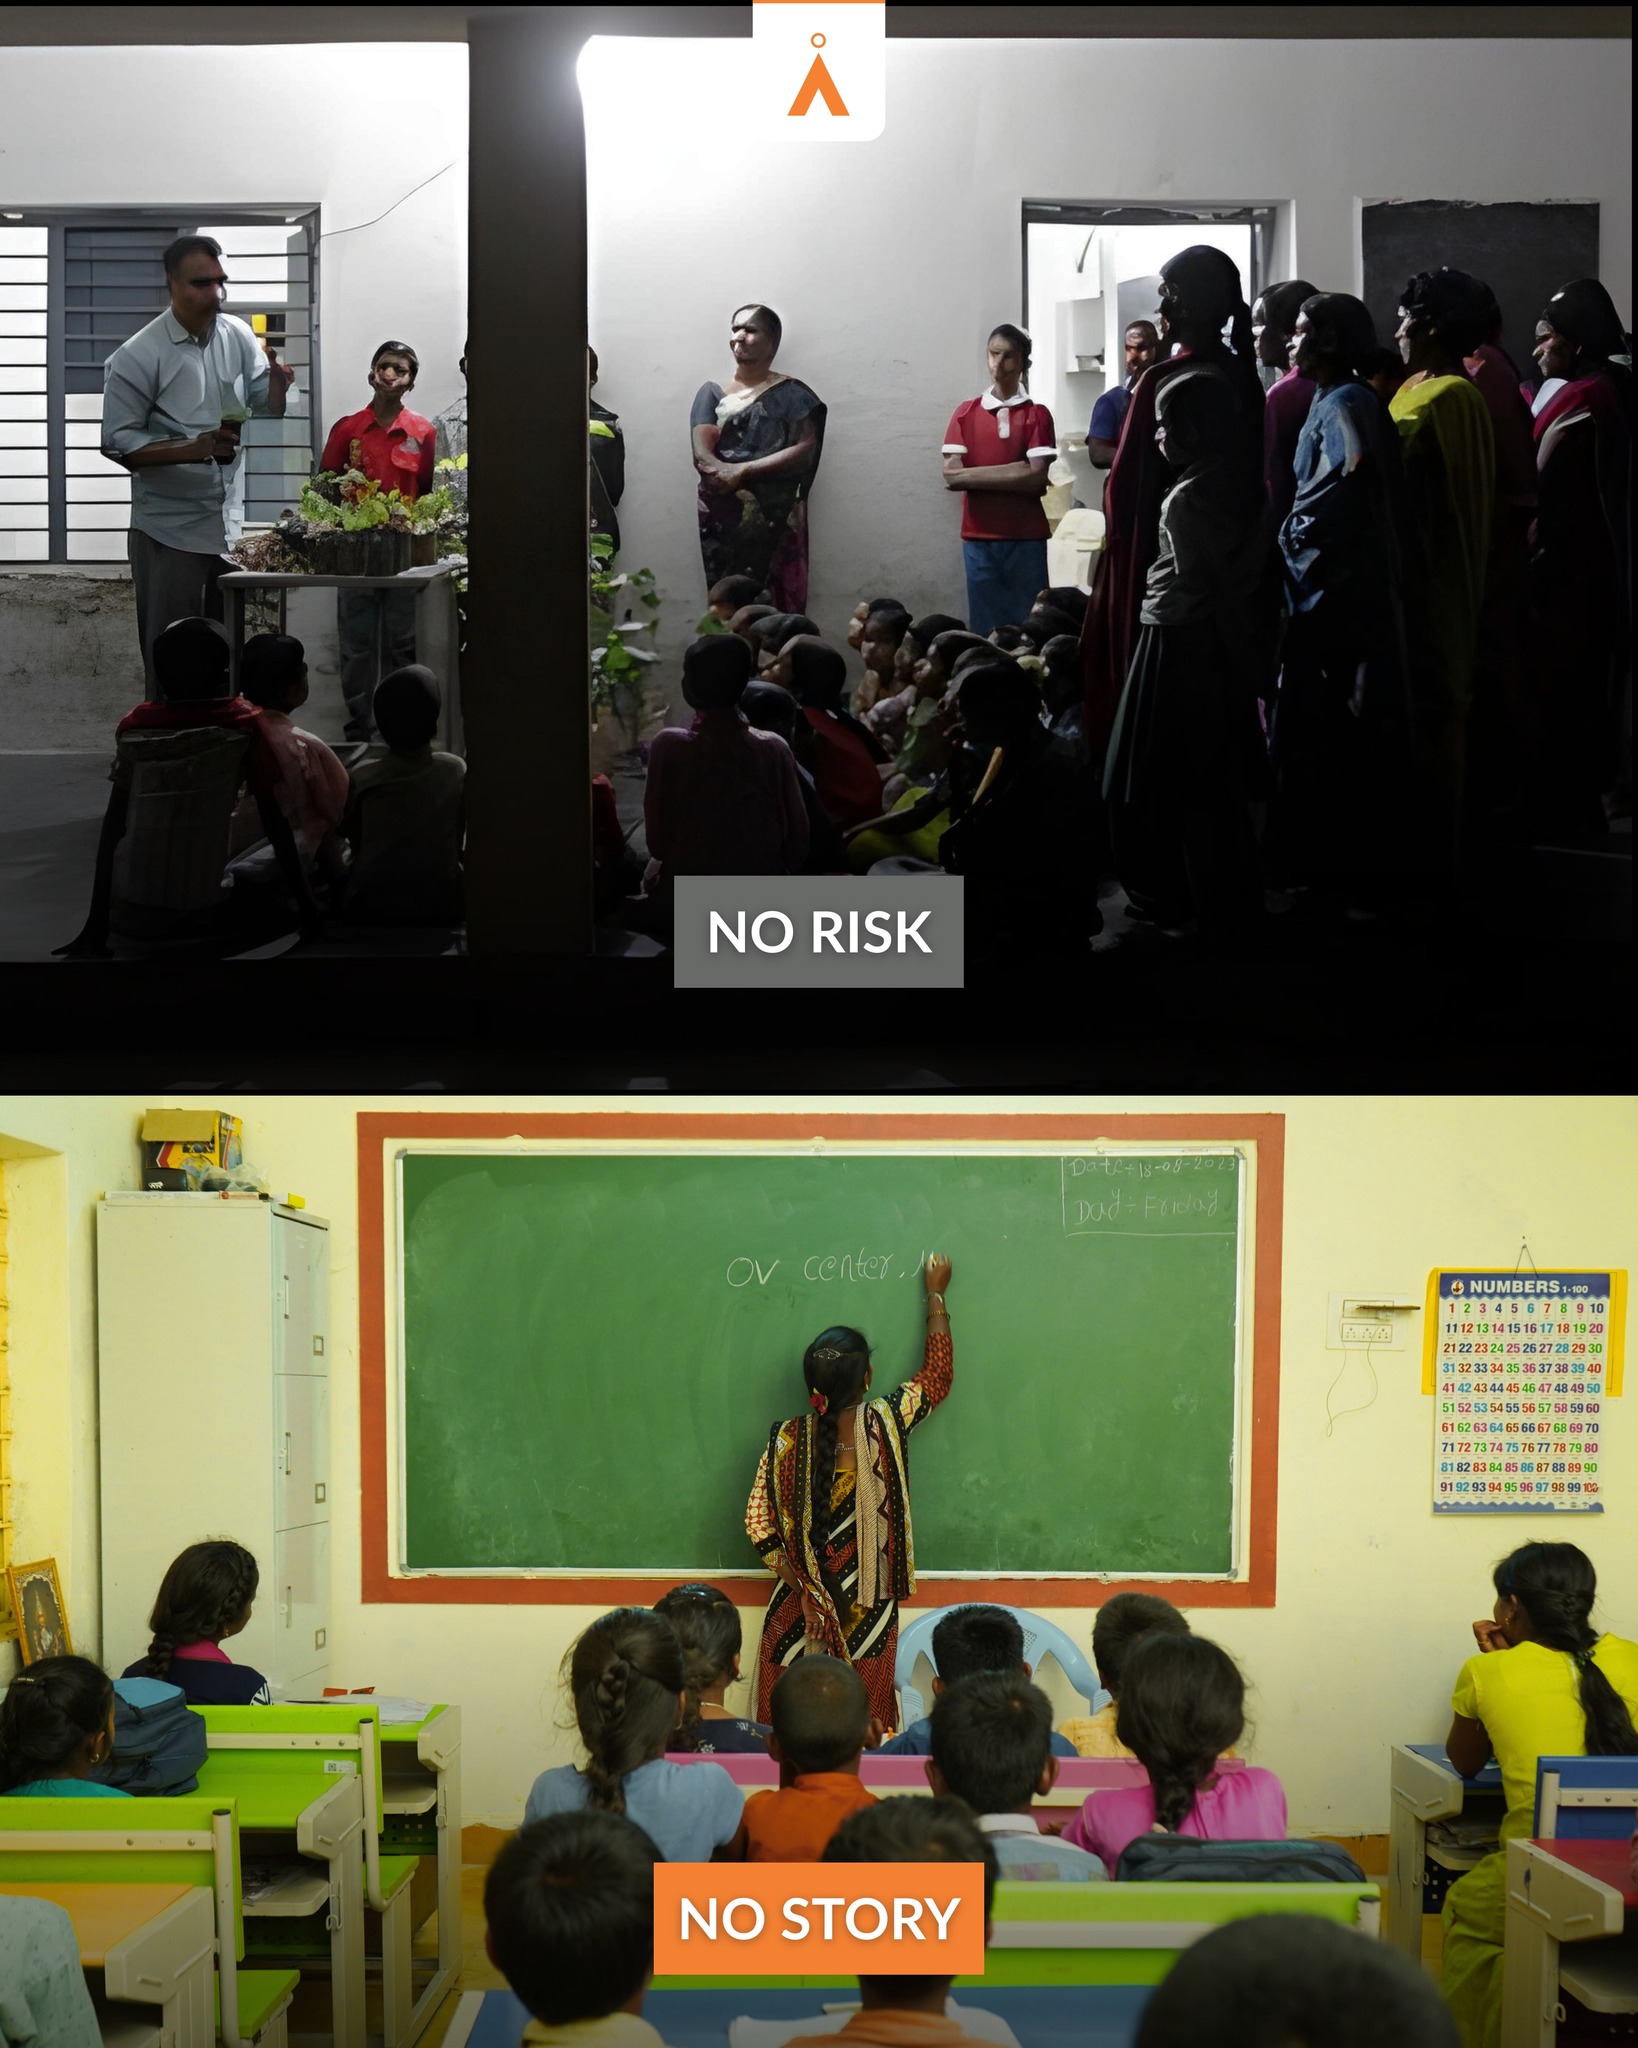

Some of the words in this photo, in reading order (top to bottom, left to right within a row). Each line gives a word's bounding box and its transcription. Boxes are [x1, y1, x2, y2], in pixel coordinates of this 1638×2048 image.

[1470, 1280, 1560, 1294] NUMBERS
[1562, 1285, 1589, 1294] 1-100
[1450, 1302, 1454, 1314] 1
[1464, 1302, 1470, 1314] 2
[1480, 1302, 1486, 1314] 3
[1494, 1302, 1502, 1314] 4
[1510, 1302, 1518, 1314] 5
[1526, 1302, 1534, 1314] 6
[1544, 1304, 1550, 1314] 7
[1560, 1302, 1568, 1314] 8
[1576, 1302, 1584, 1314] 9
[1592, 1302, 1604, 1314] 10
[1446, 1322, 1458, 1334] 11
[1462, 1322, 1474, 1334] 12
[1478, 1322, 1490, 1334] 13
[1492, 1324, 1504, 1334] 14
[1508, 1324, 1520, 1334] 15
[1524, 1322, 1538, 1334] 16
[1540, 1322, 1554, 1334] 17
[1558, 1322, 1570, 1334] 18
[1574, 1324, 1586, 1334] 19
[1588, 1324, 1604, 1334] 20
[1444, 1342, 1456, 1354] 21
[1458, 1342, 1472, 1354] 22
[1474, 1342, 1488, 1354] 23
[1490, 1342, 1504, 1354] 24
[1506, 1342, 1520, 1354] 25
[1522, 1342, 1536, 1354] 26
[1538, 1342, 1552, 1354] 27
[1556, 1342, 1570, 1354] 28
[1572, 1344, 1586, 1354] 29
[1588, 1344, 1602, 1354] 30
[1442, 1362, 1456, 1374] 31
[1458, 1362, 1472, 1374] 32
[1474, 1362, 1488, 1374] 33
[1490, 1362, 1504, 1374] 34
[1506, 1362, 1520, 1374] 35
[1522, 1362, 1536, 1374] 36
[1538, 1362, 1552, 1374] 37
[1554, 1362, 1568, 1374] 38
[1570, 1362, 1586, 1374] 39
[1586, 1364, 1602, 1374] 40
[1442, 1382, 1454, 1392] 41
[1458, 1382, 1472, 1392] 42
[1474, 1382, 1488, 1394] 43
[1490, 1382, 1504, 1392] 44
[1506, 1382, 1520, 1394] 45
[1522, 1382, 1536, 1394] 46
[1538, 1382, 1552, 1394] 47
[1554, 1382, 1568, 1394] 48
[1570, 1382, 1584, 1394] 49
[1586, 1382, 1600, 1394] 50
[1442, 1402, 1454, 1414] 51
[1458, 1402, 1472, 1412] 52
[1474, 1402, 1488, 1414] 53
[1490, 1402, 1504, 1412] 54
[1506, 1402, 1520, 1414] 55
[1522, 1402, 1536, 1414] 56
[1538, 1402, 1552, 1414] 57
[1554, 1402, 1568, 1414] 58
[1570, 1402, 1584, 1414] 59
[1586, 1402, 1600, 1414] 60
[1442, 1422, 1454, 1432] 61
[1458, 1422, 1472, 1432] 62
[1474, 1422, 1488, 1432] 63
[1490, 1422, 1504, 1432] 64
[1506, 1422, 1520, 1432] 65
[1522, 1422, 1536, 1432] 66
[1538, 1422, 1550, 1434] 67
[1554, 1422, 1568, 1434] 68
[1570, 1422, 1584, 1434] 69
[1586, 1422, 1600, 1434] 70
[1442, 1442, 1454, 1452] 71
[1458, 1442, 1472, 1452] 72
[1474, 1442, 1486, 1454] 73
[1490, 1442, 1502, 1452] 74
[1506, 1442, 1518, 1452] 75
[1522, 1442, 1534, 1452] 76
[1536, 1442, 1550, 1452] 77
[1552, 1442, 1566, 1452] 78
[1568, 1442, 1582, 1454] 79
[1584, 1442, 1598, 1454] 80
[1440, 1462, 1454, 1472] 81
[1456, 1462, 1470, 1472] 82
[1472, 1462, 1486, 1472] 83
[1488, 1462, 1502, 1472] 84
[1504, 1462, 1518, 1472] 85
[1520, 1462, 1534, 1472] 86
[1536, 1462, 1550, 1472] 87
[1552, 1462, 1566, 1472] 88
[1568, 1462, 1582, 1472] 89
[1584, 1462, 1598, 1474] 90
[1440, 1482, 1452, 1492] 91
[1456, 1482, 1470, 1492] 92
[1472, 1482, 1486, 1492] 93
[1488, 1482, 1502, 1492] 94
[1504, 1482, 1518, 1492] 95
[1520, 1482, 1534, 1492] 96
[1536, 1482, 1550, 1492] 97
[1552, 1482, 1564, 1492] 98
[1568, 1482, 1582, 1492] 99
